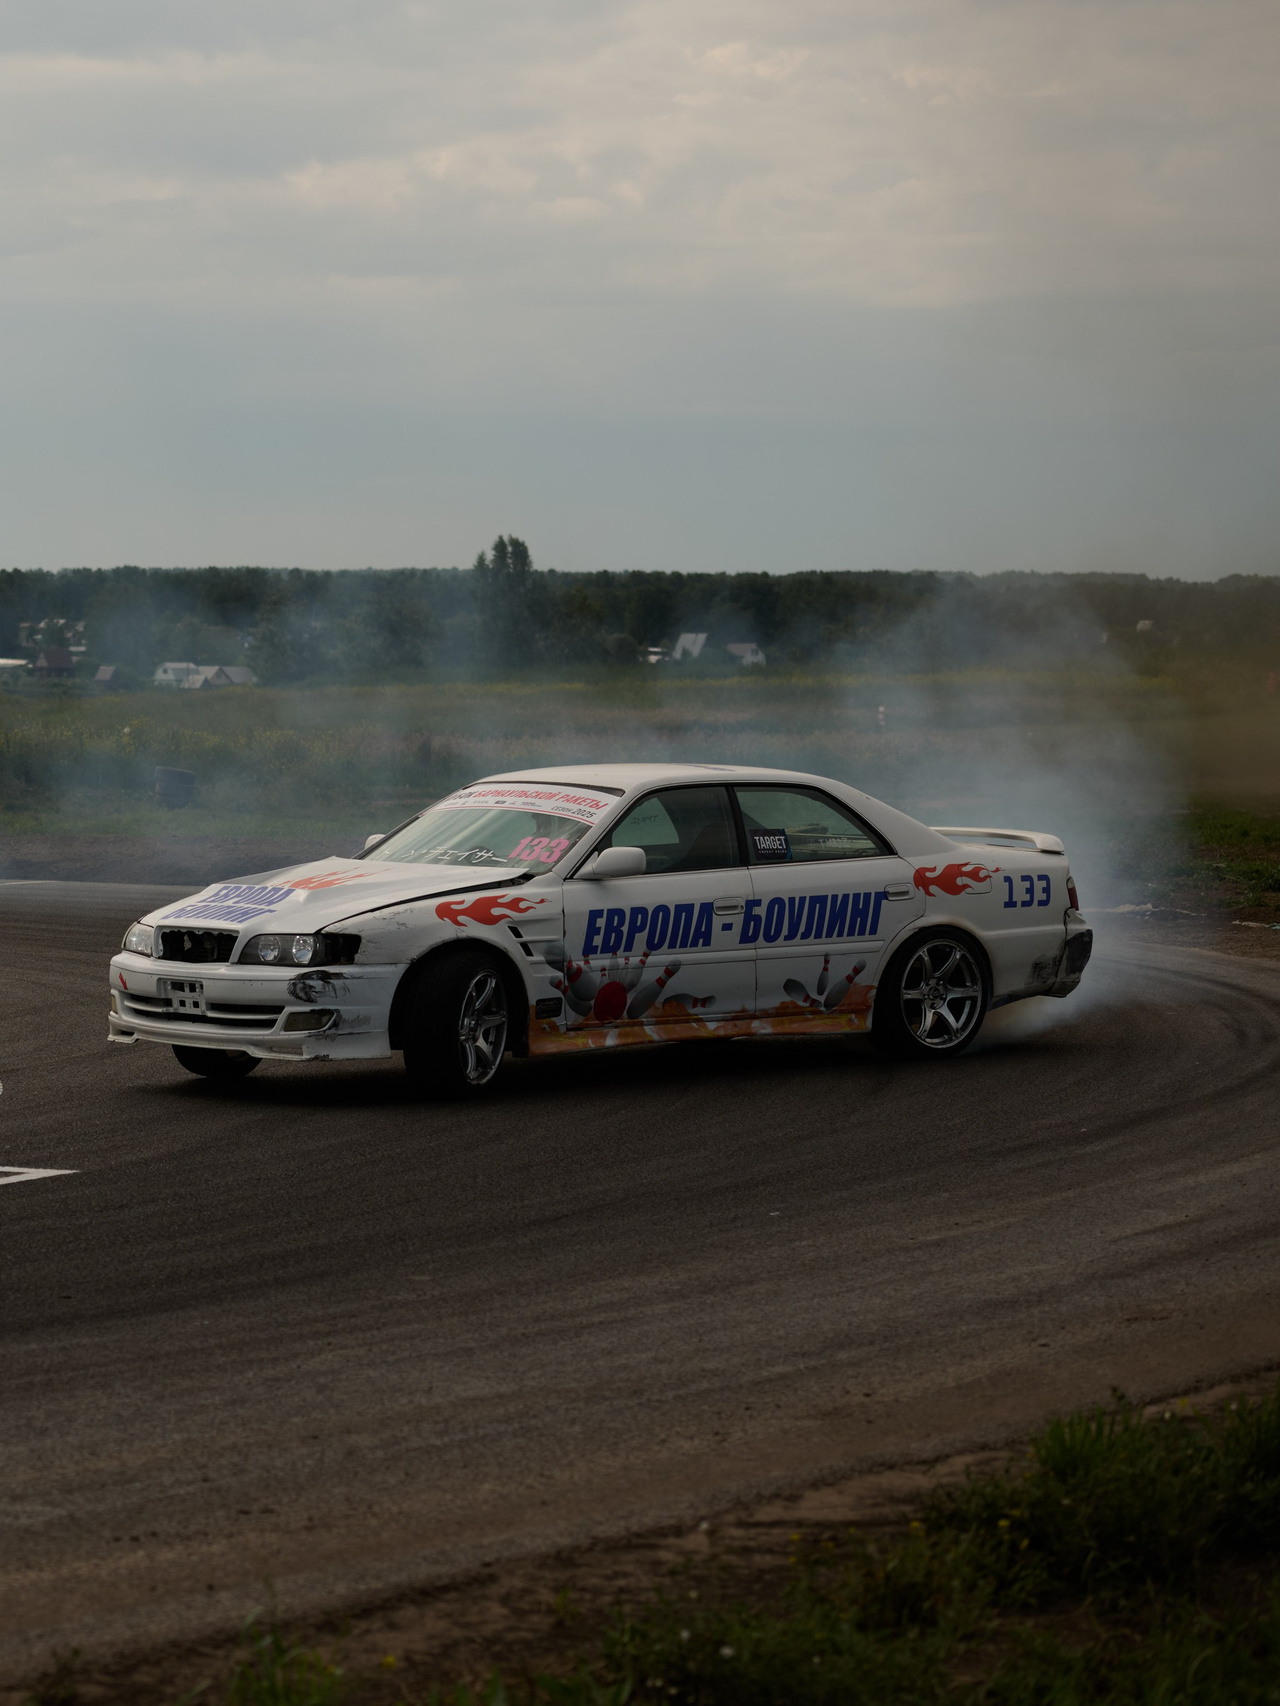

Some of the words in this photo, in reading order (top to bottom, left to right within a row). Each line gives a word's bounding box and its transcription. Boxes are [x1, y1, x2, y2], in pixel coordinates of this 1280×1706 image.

[472, 789, 561, 801] БАРНАУЛЬСКОЙ
[558, 793, 609, 810] РАКЕТЫ
[551, 805, 573, 813] СЕЗОН
[571, 808, 597, 819] 2025
[507, 836, 570, 863] 133
[753, 835, 787, 849] TARGET
[195, 885, 297, 907] ЕВРОПА
[1003, 874, 1051, 909] 133
[161, 904, 278, 924] БОУЛИНГ
[582, 902, 714, 956] ЕВРОПА
[738, 891, 889, 945] БОУЛИНГ
